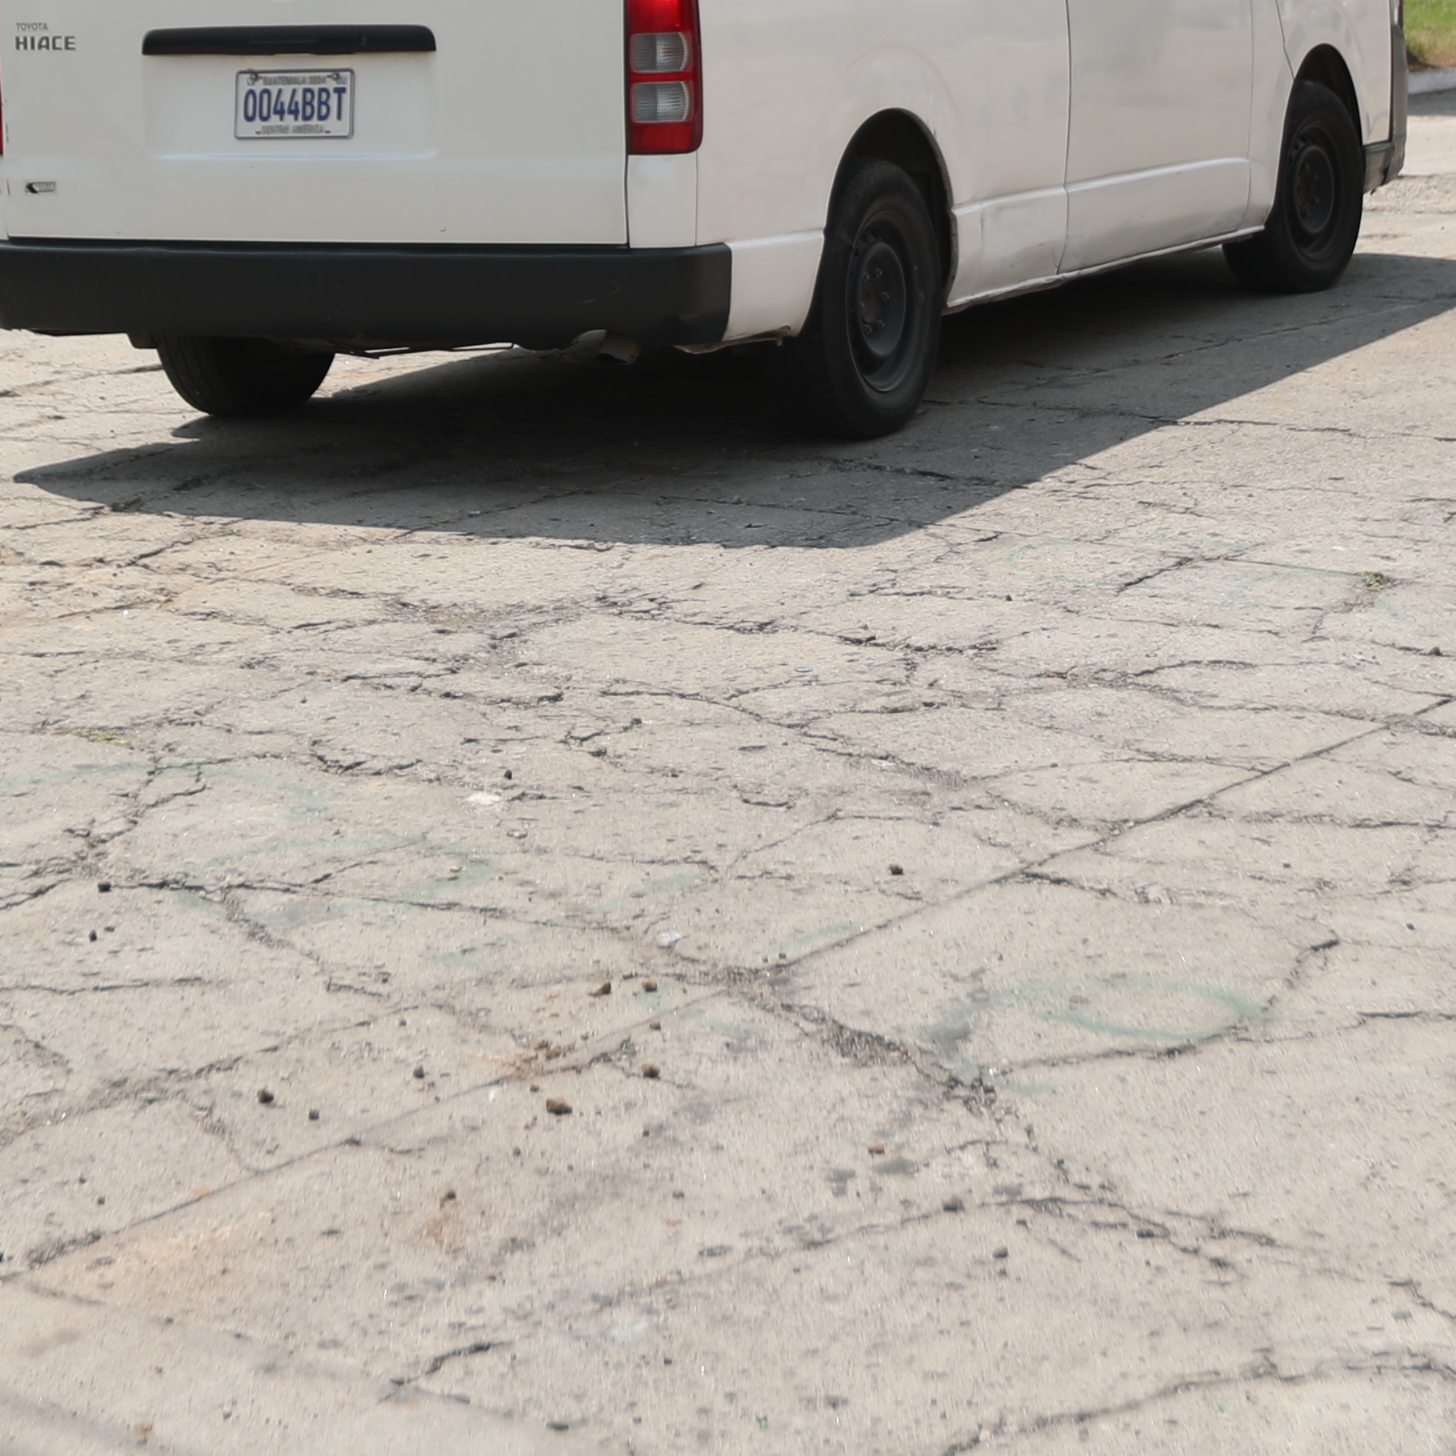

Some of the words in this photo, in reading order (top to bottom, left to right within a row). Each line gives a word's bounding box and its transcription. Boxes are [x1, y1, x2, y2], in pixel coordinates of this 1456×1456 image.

[16, 22, 49, 31] TOYOTA
[15, 35, 77, 51] HIACE
[243, 87, 347, 122] 0044BBT
